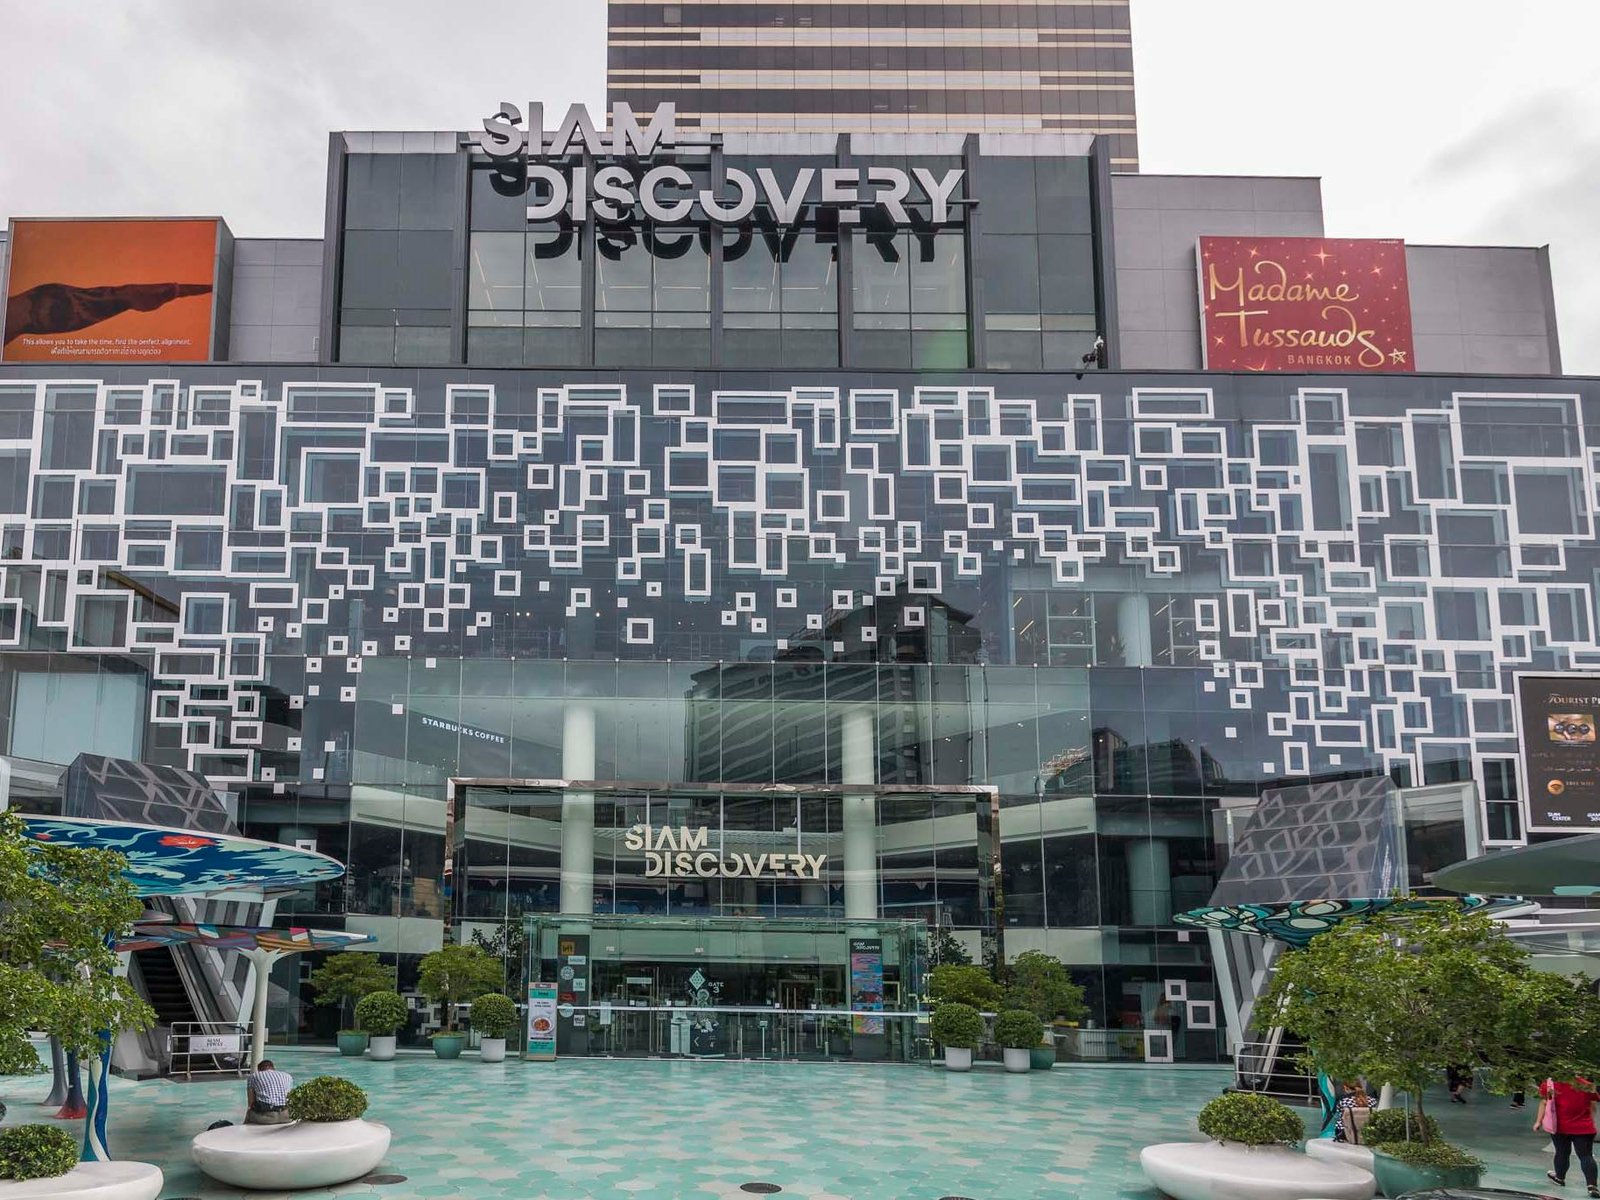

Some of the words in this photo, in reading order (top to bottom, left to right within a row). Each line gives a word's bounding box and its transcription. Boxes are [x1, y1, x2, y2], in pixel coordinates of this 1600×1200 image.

[480, 101, 676, 158] SIAM
[526, 165, 966, 225] DISCOVERY
[1209, 260, 1359, 306] Madame
[23, 338, 35, 346] This
[36, 338, 54, 346] allows
[55, 339, 66, 348] you
[1215, 305, 1385, 367] Tussauds
[1287, 354, 1352, 366] BANGKOK
[1549, 693, 1589, 704] TOURIST
[422, 717, 474, 736] STARBUCKS
[474, 730, 505, 744] COFFEE
[624, 824, 708, 851] SIAM
[645, 851, 827, 879] DISCOVERY
